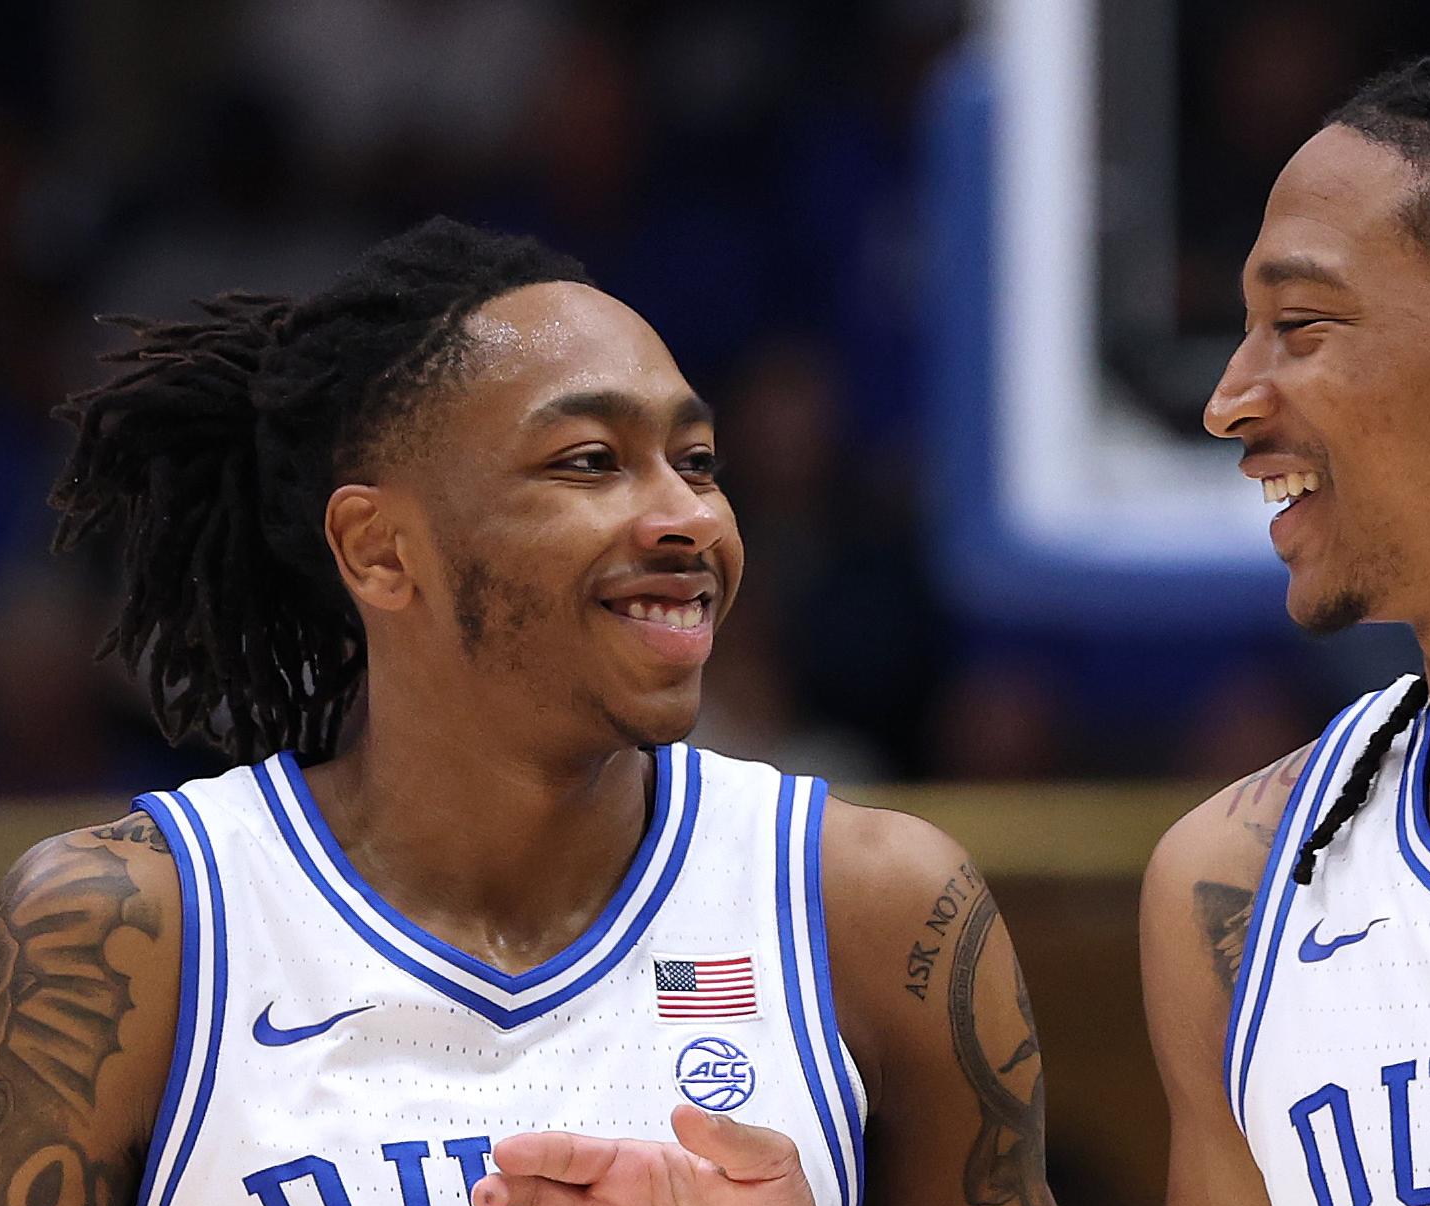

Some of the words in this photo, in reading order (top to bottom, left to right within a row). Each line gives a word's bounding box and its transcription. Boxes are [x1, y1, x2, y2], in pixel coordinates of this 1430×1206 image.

[905, 941, 940, 1000] ASK
[925, 878, 967, 936] NOT
[688, 1061, 749, 1077] ACC
